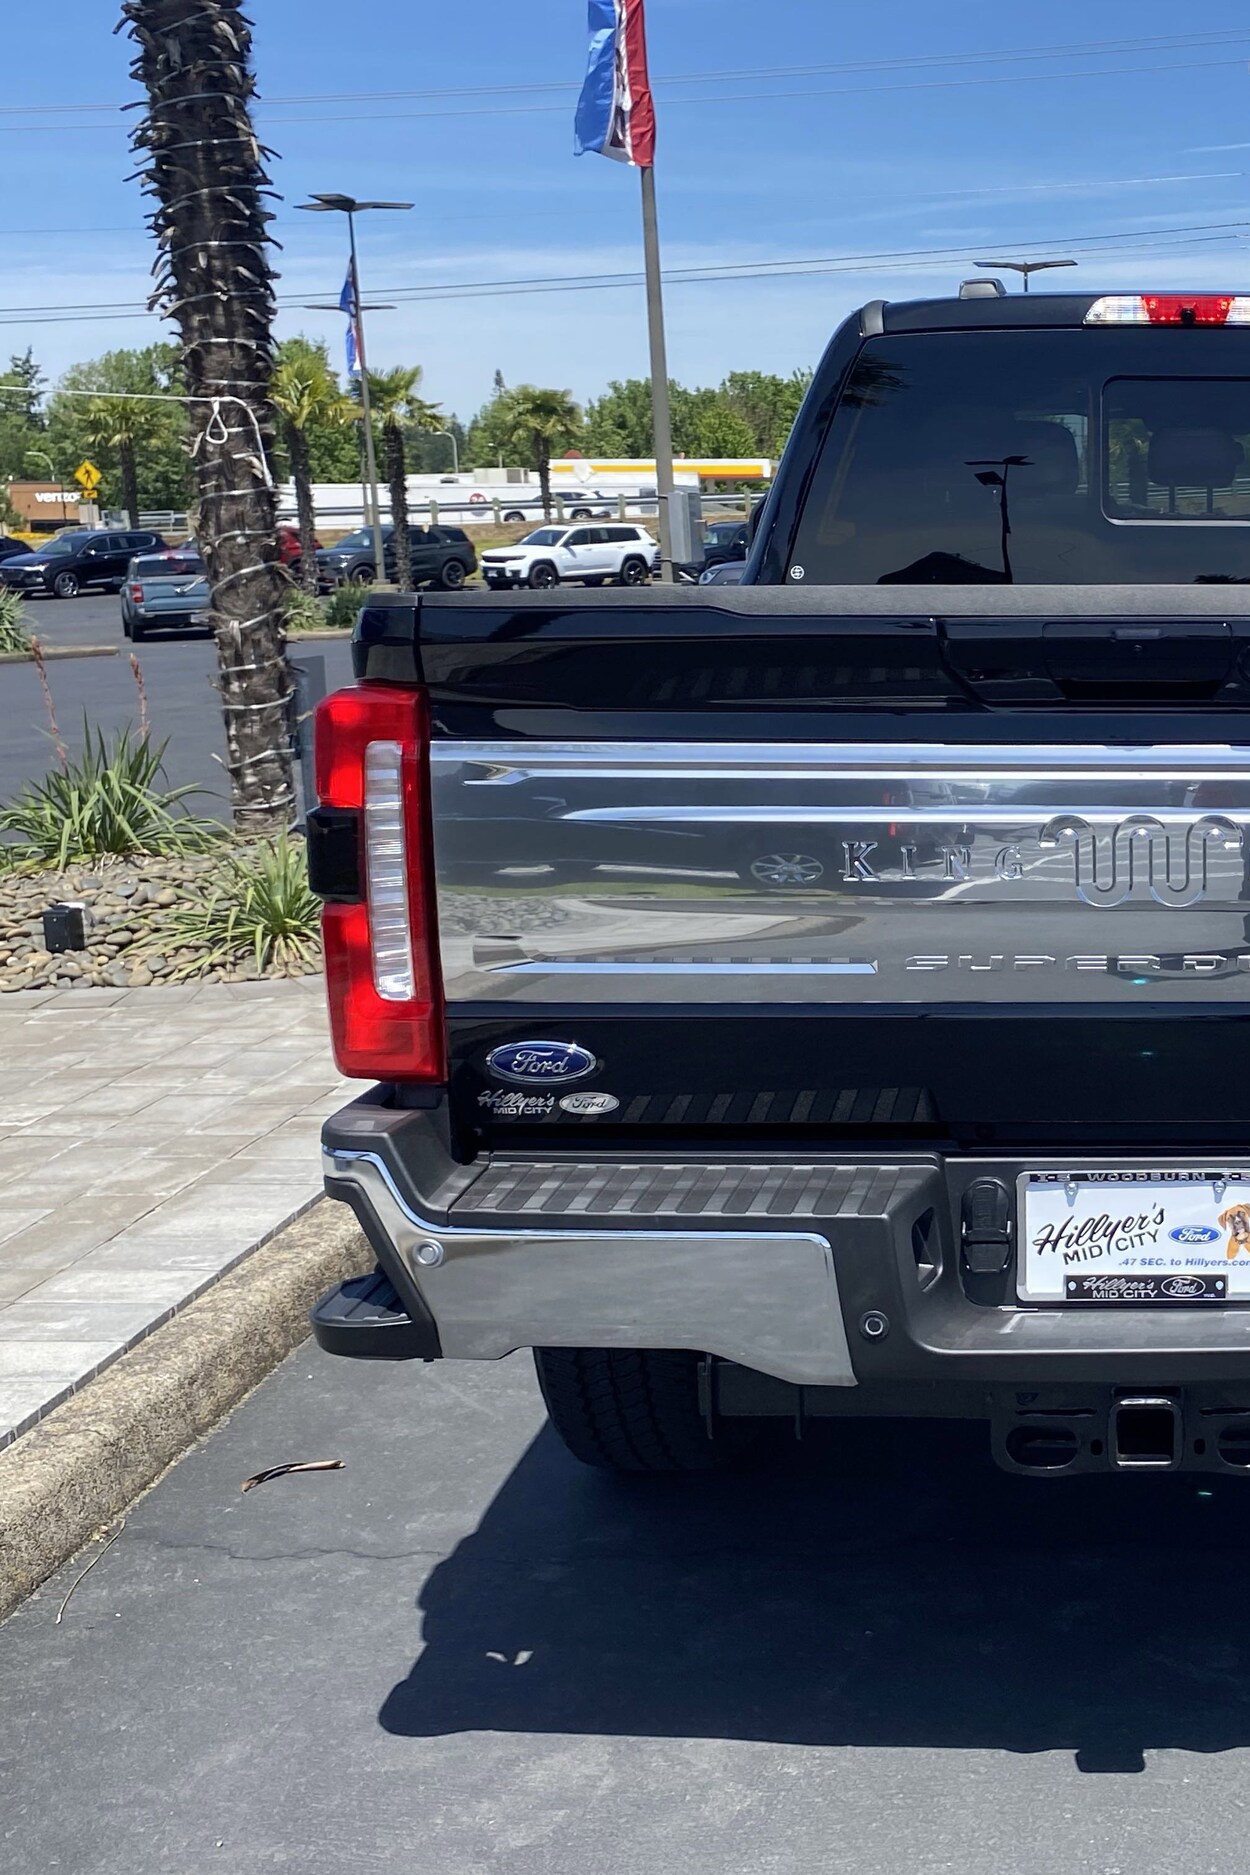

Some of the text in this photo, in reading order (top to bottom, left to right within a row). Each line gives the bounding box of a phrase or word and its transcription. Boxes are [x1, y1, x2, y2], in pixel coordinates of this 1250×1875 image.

[841, 840, 1025, 882] KING
[905, 953, 1162, 971] SUPER
[509, 1048, 571, 1075] Ford
[477, 1088, 609, 1115] Hillyer's Ford
[493, 1106, 553, 1115] MID CITY
[1086, 1172, 1206, 1183] WOODBURN
[1032, 1202, 1165, 1256] Hillyer's
[1062, 1226, 1212, 1266] MID CITY Ford
[1139, 1257, 1167, 1267] SEC.
[1170, 1258, 1182, 1266] to
[1082, 1276, 1199, 1295] Hillyer's Ford
[1092, 1289, 1159, 1299] MID CITY
